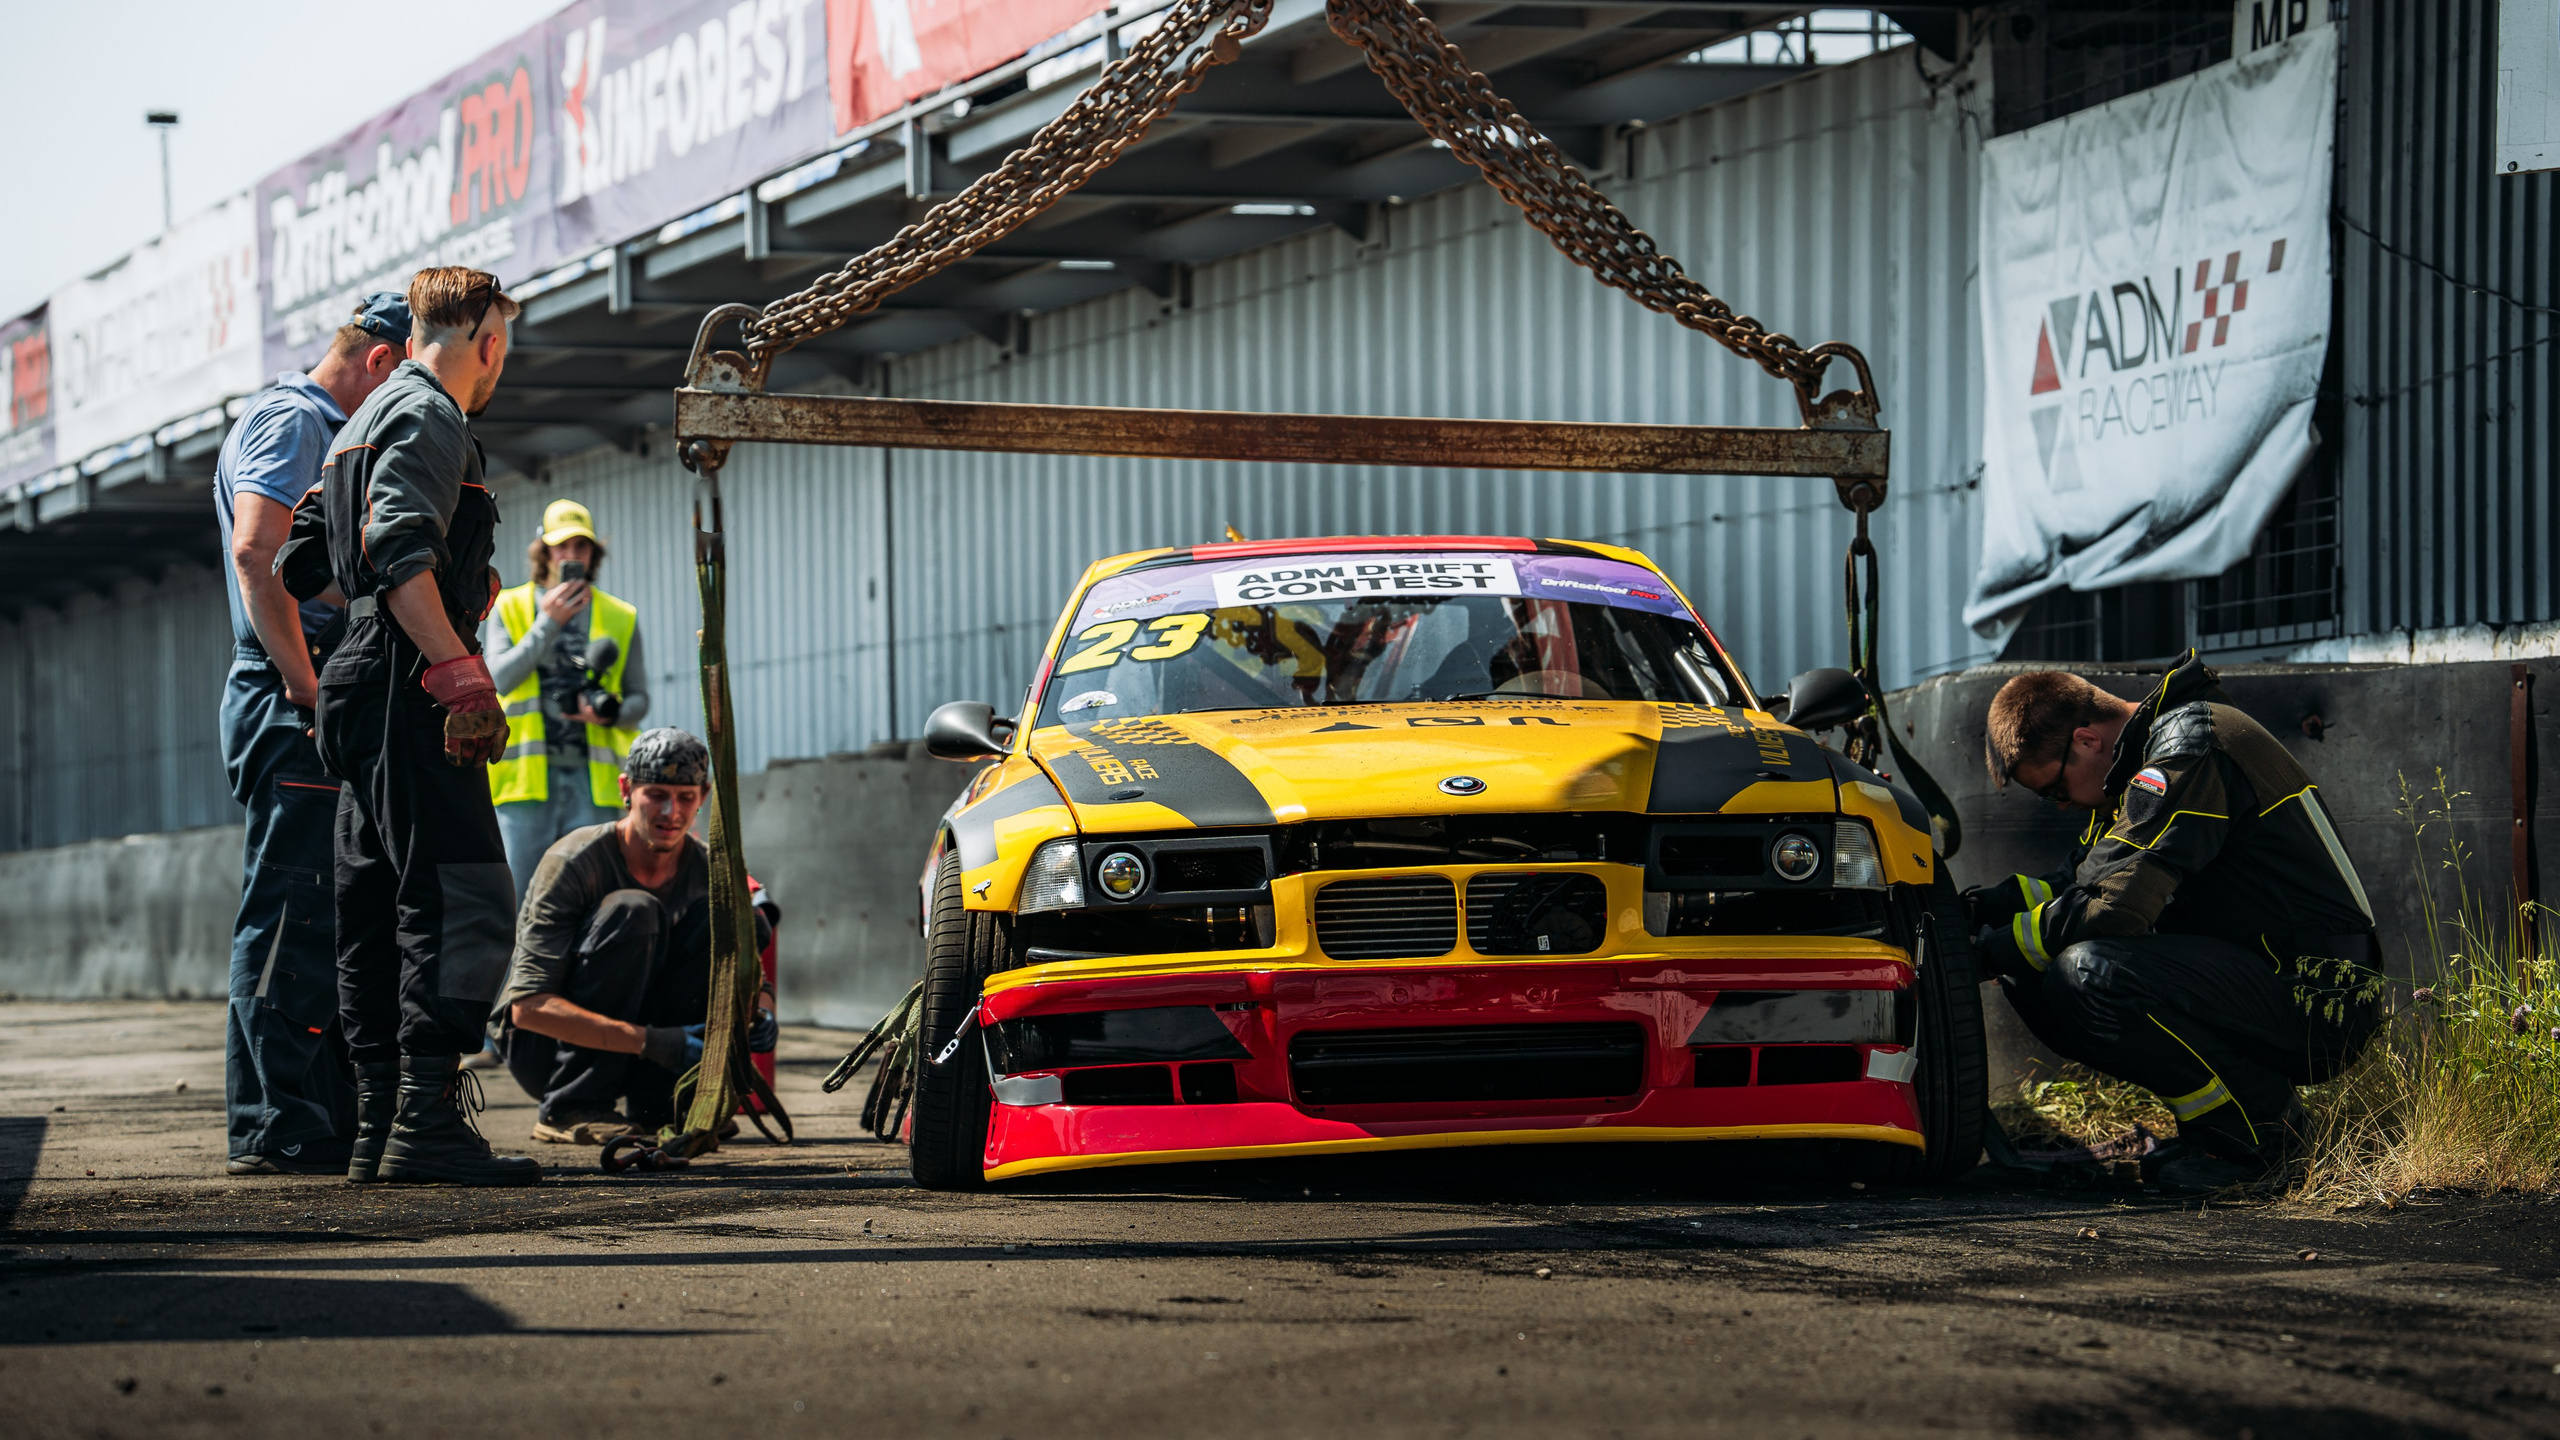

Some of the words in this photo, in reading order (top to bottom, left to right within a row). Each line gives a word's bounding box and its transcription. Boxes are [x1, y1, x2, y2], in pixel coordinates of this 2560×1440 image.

[2080, 266, 2182, 379] ADM
[2077, 358, 2226, 445] RACEWAY
[1237, 567, 1345, 586] ADM
[1355, 563, 1492, 576] DRIFT
[1238, 575, 1496, 600] CONTEST
[1057, 612, 1212, 676] 23
[1127, 758, 1160, 780] RACE
